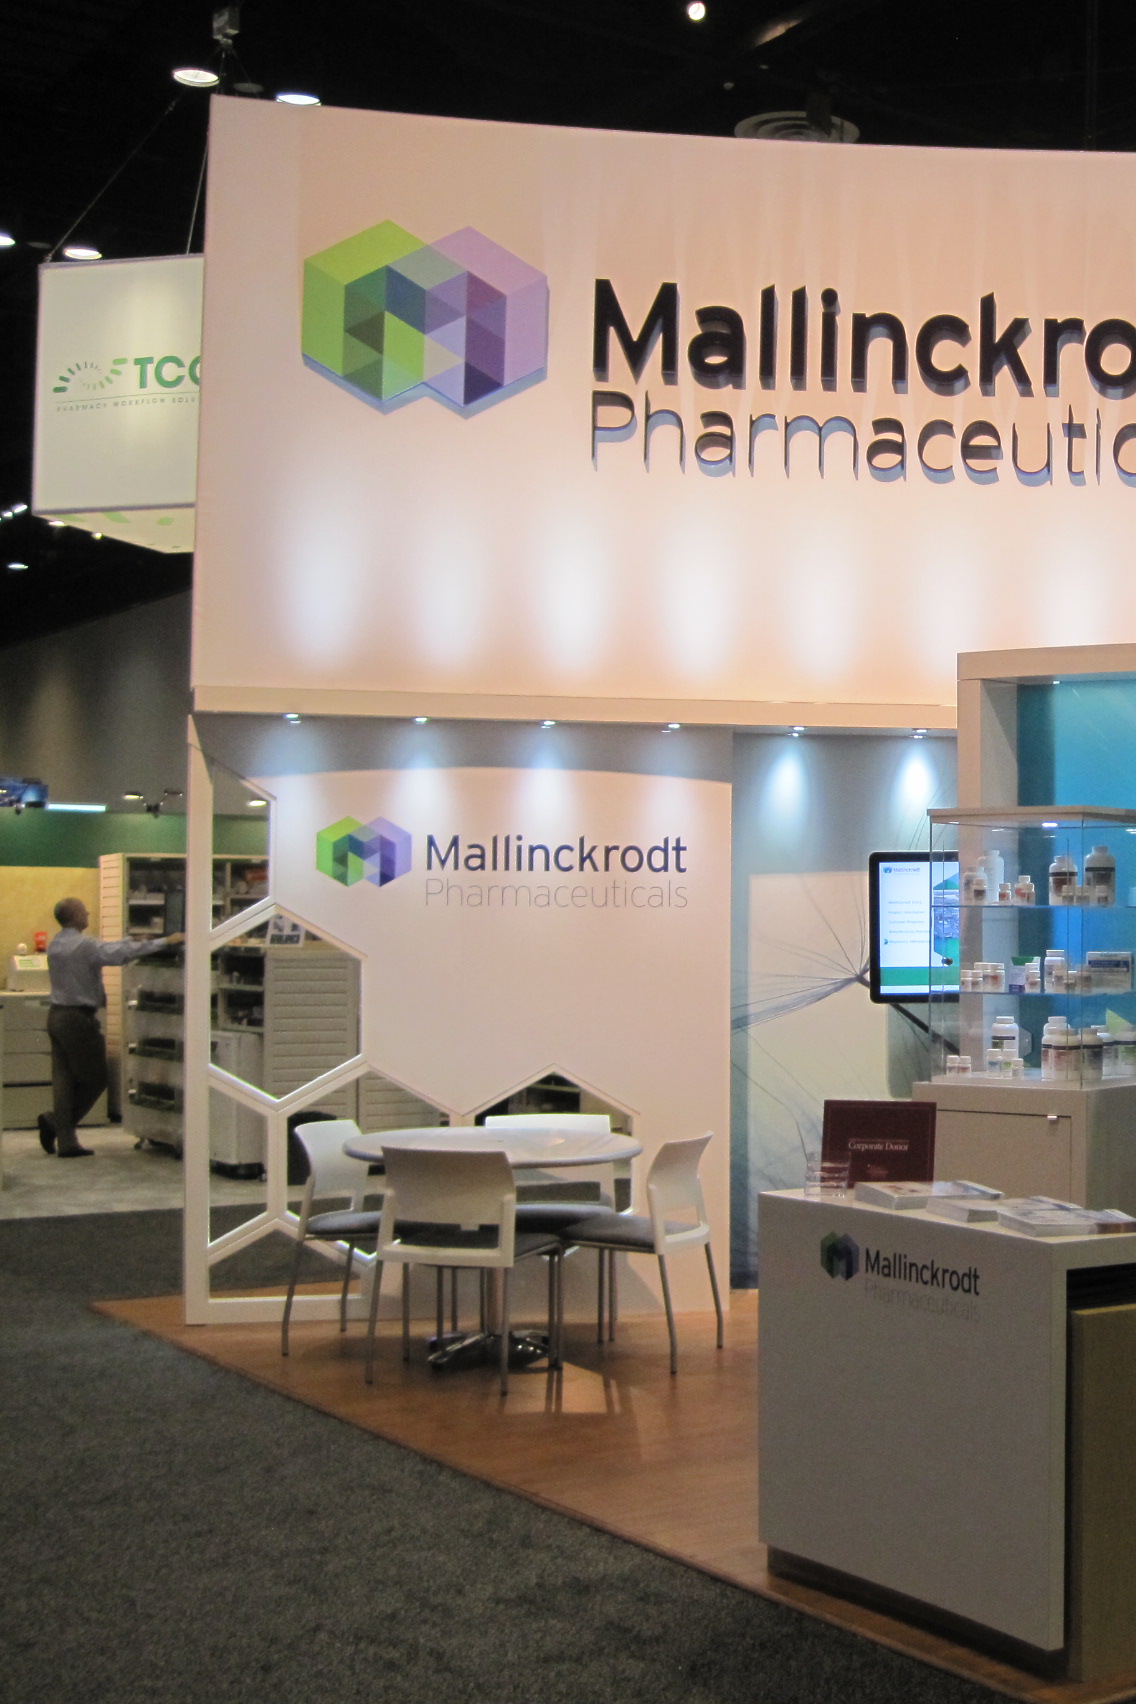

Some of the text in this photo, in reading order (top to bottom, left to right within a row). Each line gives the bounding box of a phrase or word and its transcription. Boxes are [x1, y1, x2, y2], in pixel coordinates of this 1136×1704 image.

[57, 403, 107, 412] PHARMACY
[113, 397, 165, 407] WORKFLOW
[425, 834, 688, 873] Mallinckrodt
[425, 878, 688, 908] Pharmaceuticals
[848, 1141, 909, 1151] Corporate Donor
[865, 1247, 980, 1296] Mallinckrodt
